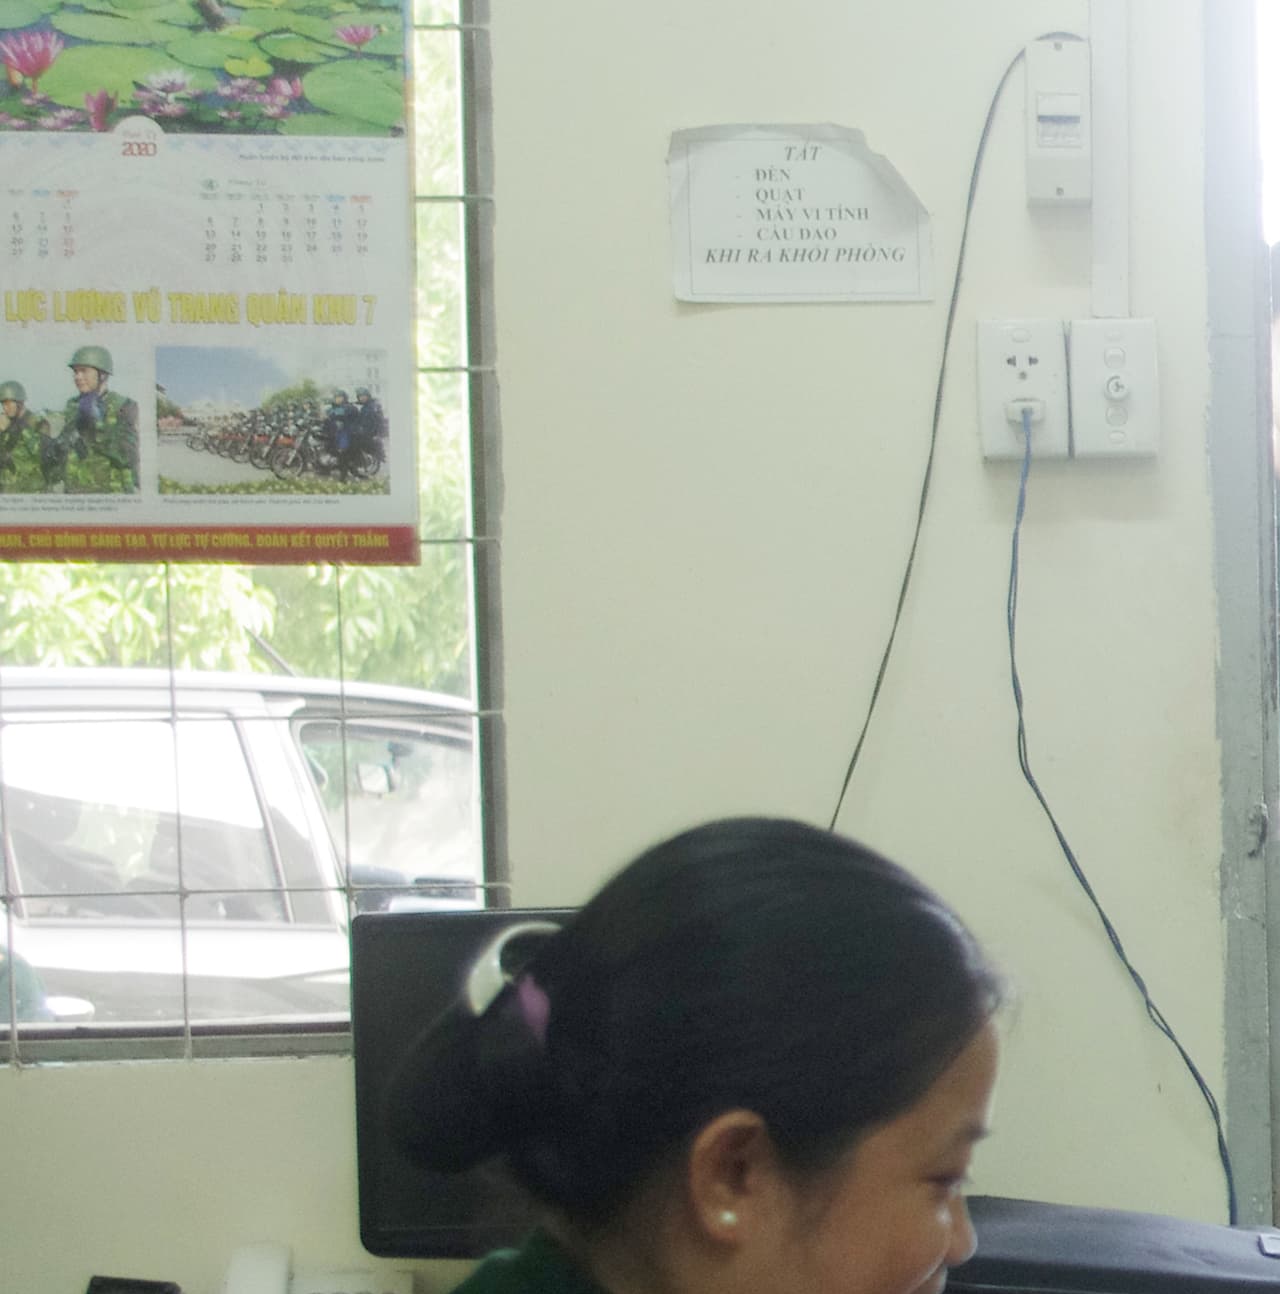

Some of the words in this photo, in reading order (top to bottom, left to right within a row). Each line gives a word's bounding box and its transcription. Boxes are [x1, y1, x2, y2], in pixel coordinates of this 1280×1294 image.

[802, 207, 821, 221] VI
[800, 227, 838, 241] DAO
[705, 248, 742, 263] KHI
[747, 247, 773, 263] RA
[168, 292, 240, 324] TRANG
[246, 288, 307, 328] QUÂN
[313, 293, 357, 325] KHU
[362, 295, 377, 325] 7
